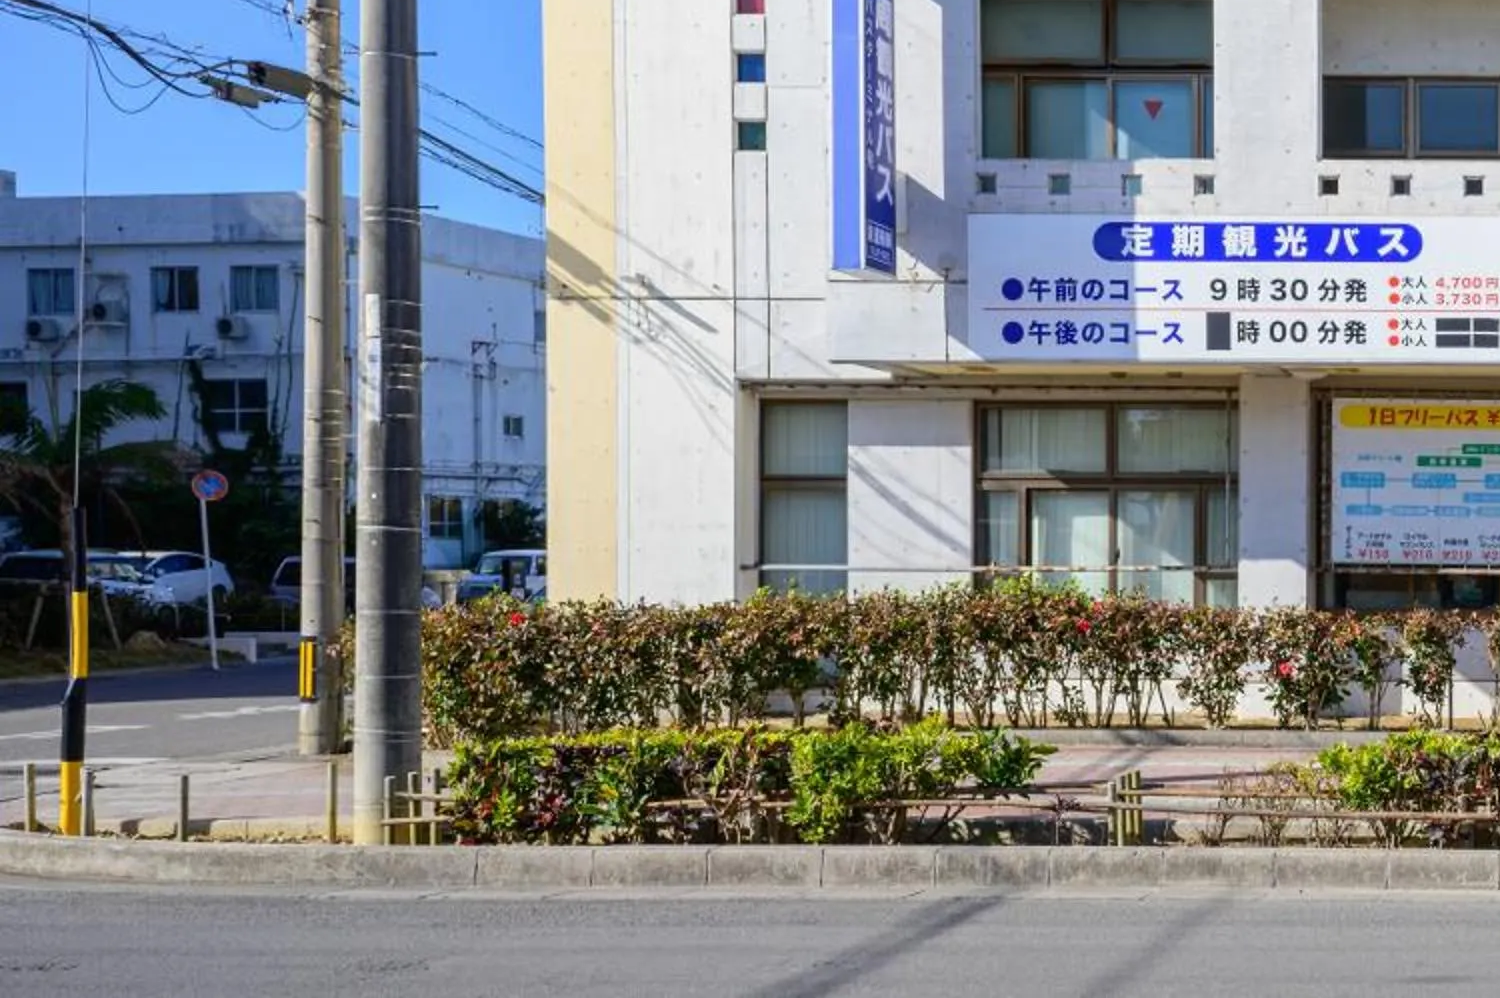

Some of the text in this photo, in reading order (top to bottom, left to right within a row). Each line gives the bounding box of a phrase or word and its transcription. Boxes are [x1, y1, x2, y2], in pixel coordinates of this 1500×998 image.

[1120, 223, 1409, 258] 定期観光バス
[1401, 276, 1428, 288] 大人
[1028, 277, 1184, 301] 午前のコース
[1401, 293, 1428, 305] 小人
[1401, 318, 1427, 330] 大人
[1028, 320, 1184, 345] 午後のコース
[1401, 335, 1427, 347] 小人
